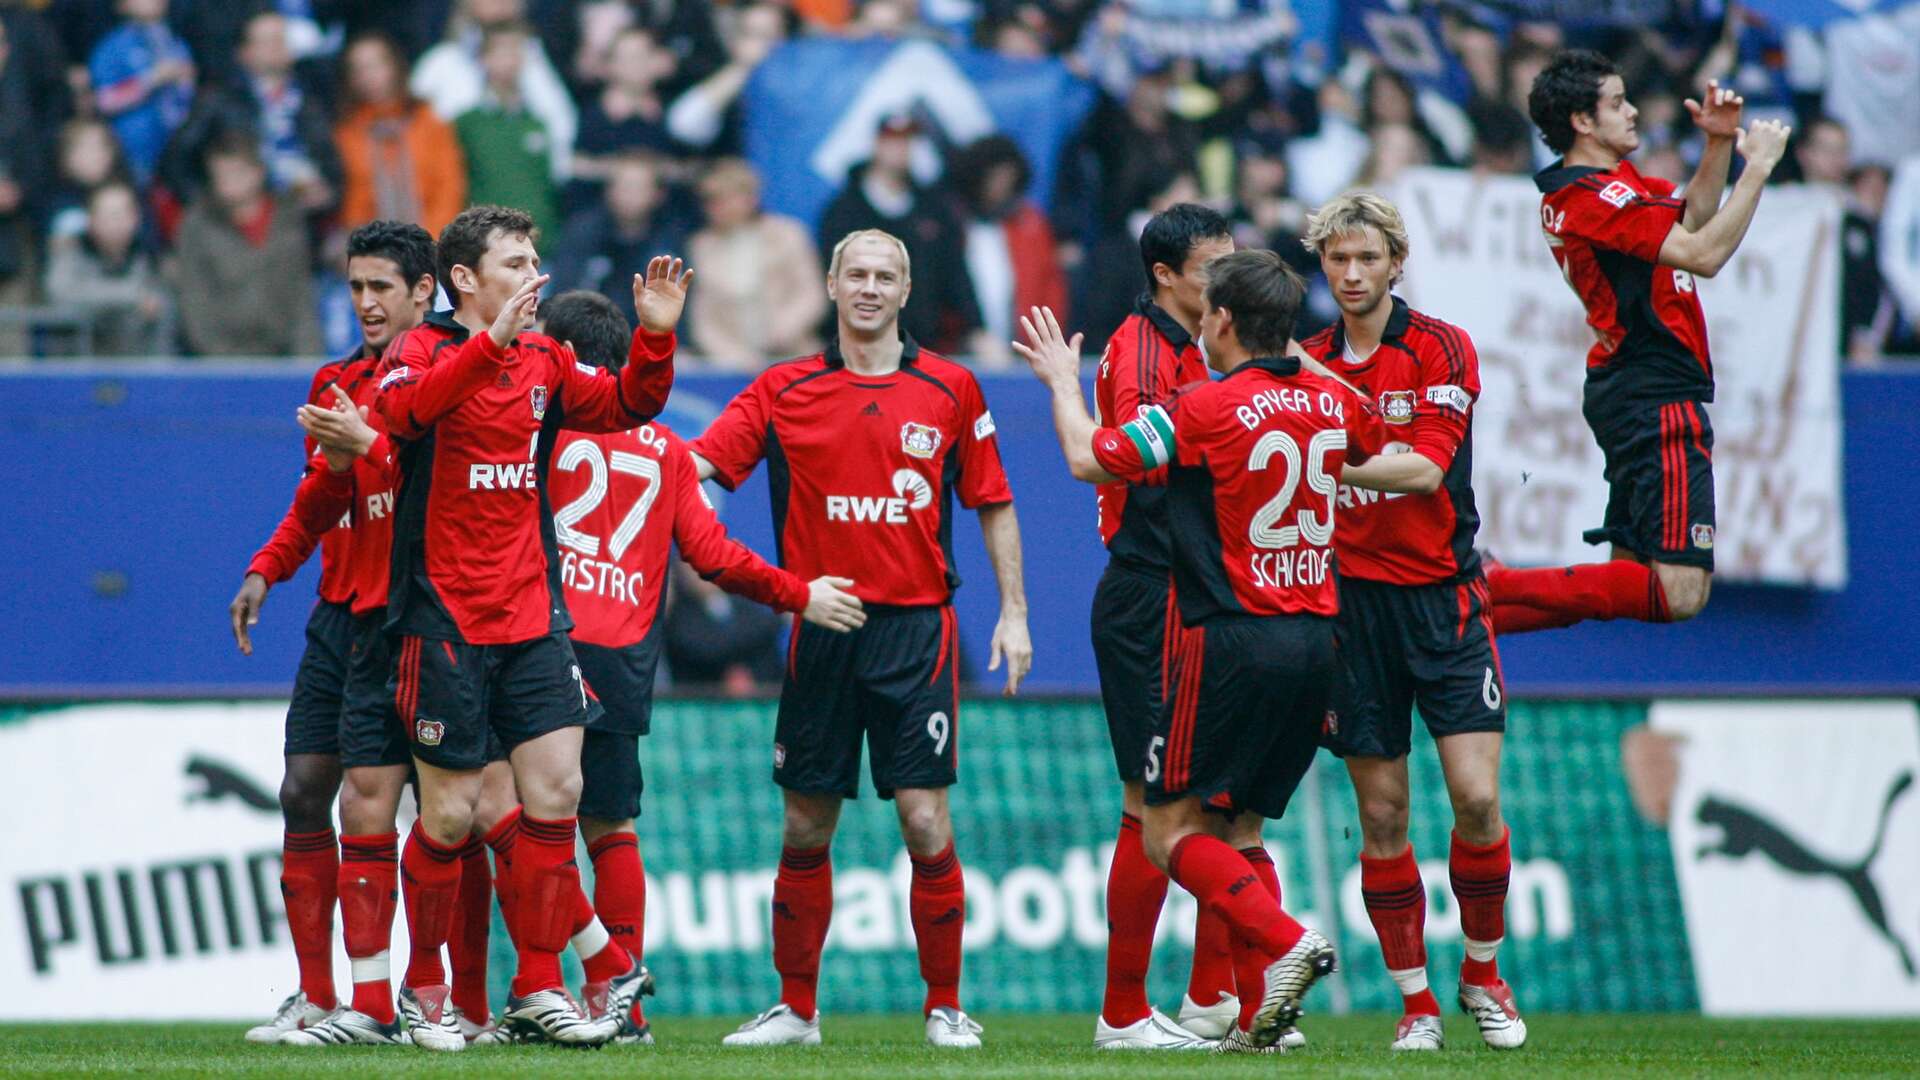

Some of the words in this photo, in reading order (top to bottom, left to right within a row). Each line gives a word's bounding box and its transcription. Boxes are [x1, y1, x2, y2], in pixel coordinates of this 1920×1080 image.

[1237, 388, 1311, 430] BAYER
[1319, 391, 1345, 424] 04
[554, 439, 661, 562] 27
[827, 495, 908, 523] RWE
[1248, 429, 1347, 549] 25
[1483, 667, 1501, 710] 6
[928, 711, 949, 757] 9
[1145, 735, 1164, 783] 5
